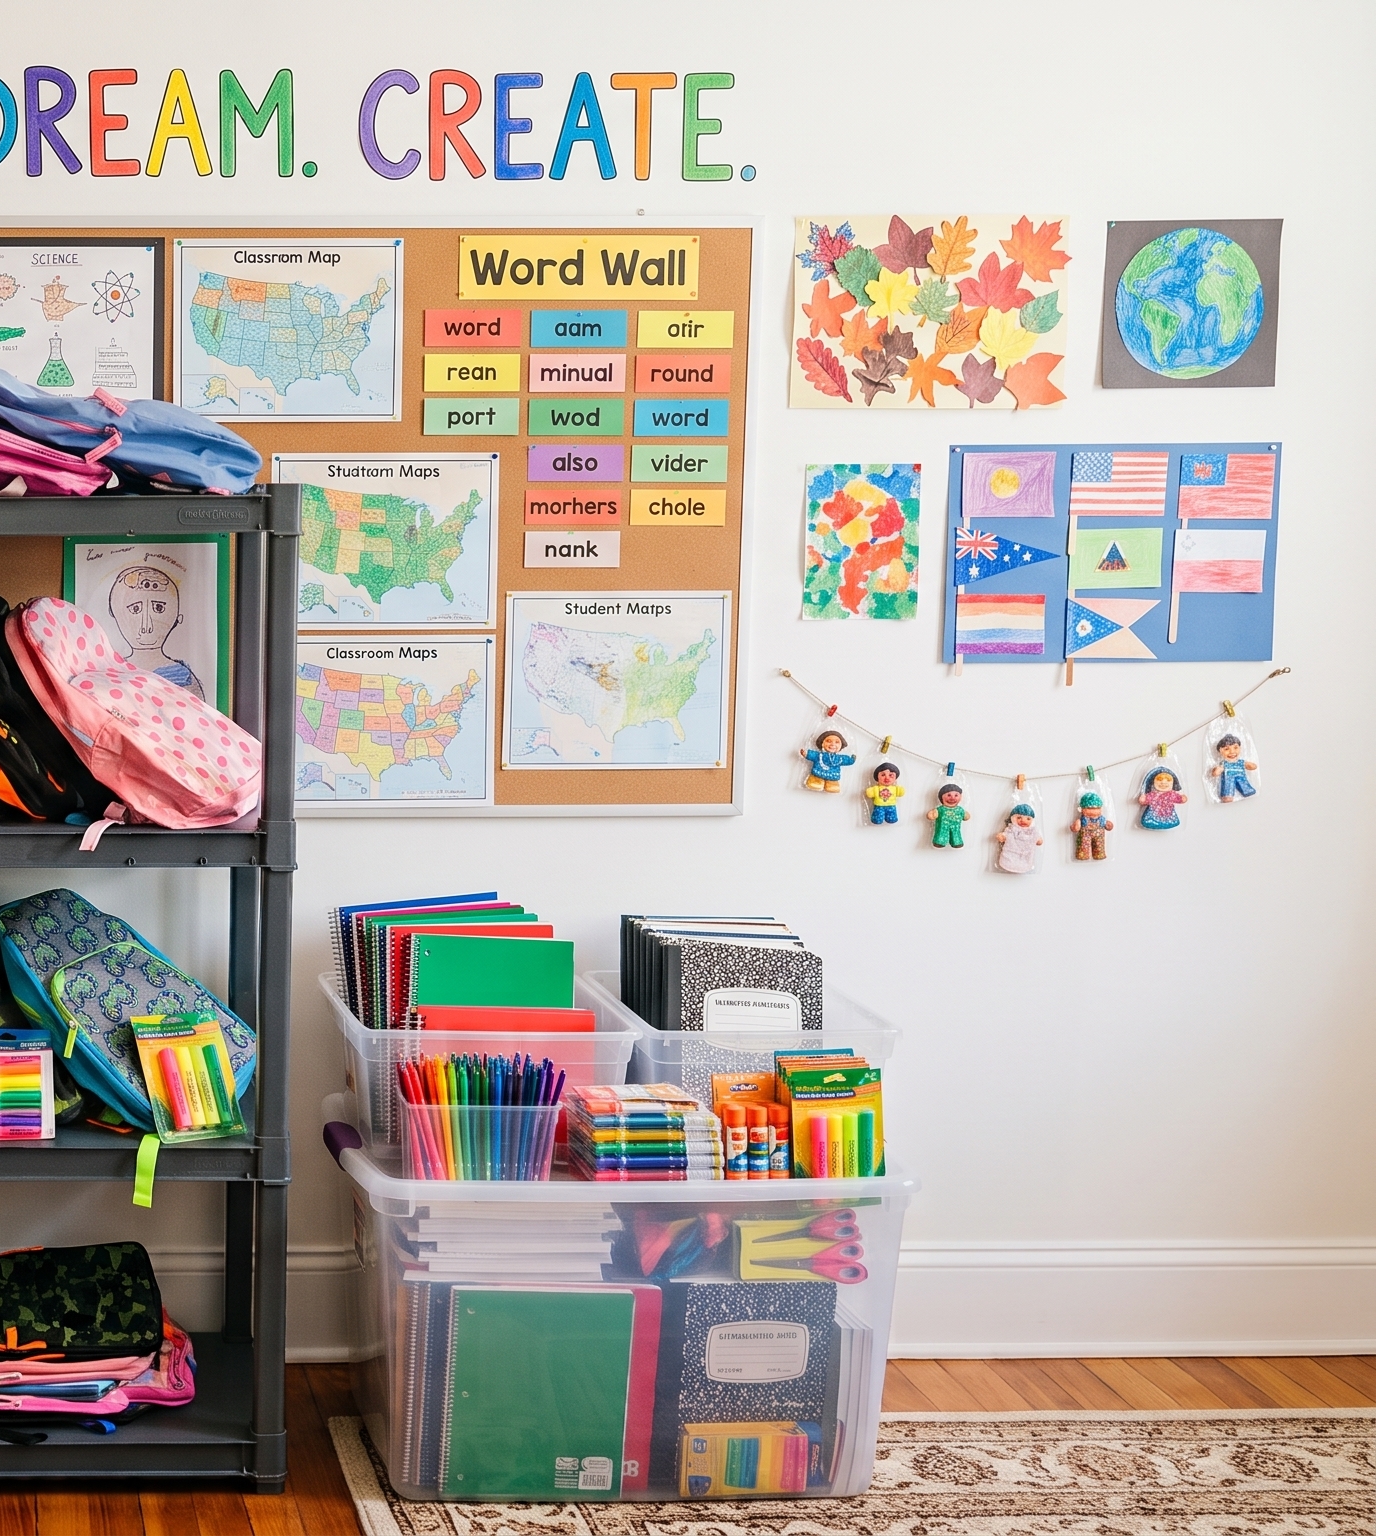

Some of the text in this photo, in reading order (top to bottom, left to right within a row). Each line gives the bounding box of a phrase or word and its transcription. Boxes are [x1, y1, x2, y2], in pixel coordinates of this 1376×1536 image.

[357, 68, 757, 182] CREATE.
[31, 252, 80, 265] SCIENCE
[307, 250, 341, 267] Map
[469, 248, 686, 286] Word Wall
[443, 317, 501, 336] word
[554, 322, 602, 337] aam
[447, 366, 497, 381] rean
[540, 362, 613, 382] minual
[650, 364, 714, 383] round
[447, 407, 496, 429] port
[652, 408, 709, 427] word
[552, 452, 598, 472] also
[650, 453, 709, 473] vider
[399, 464, 440, 480] Maps
[530, 497, 617, 515] morhers
[648, 497, 706, 516] chole
[545, 540, 599, 558] nank
[565, 602, 622, 615] Student
[326, 646, 438, 662] Classroom Maps
